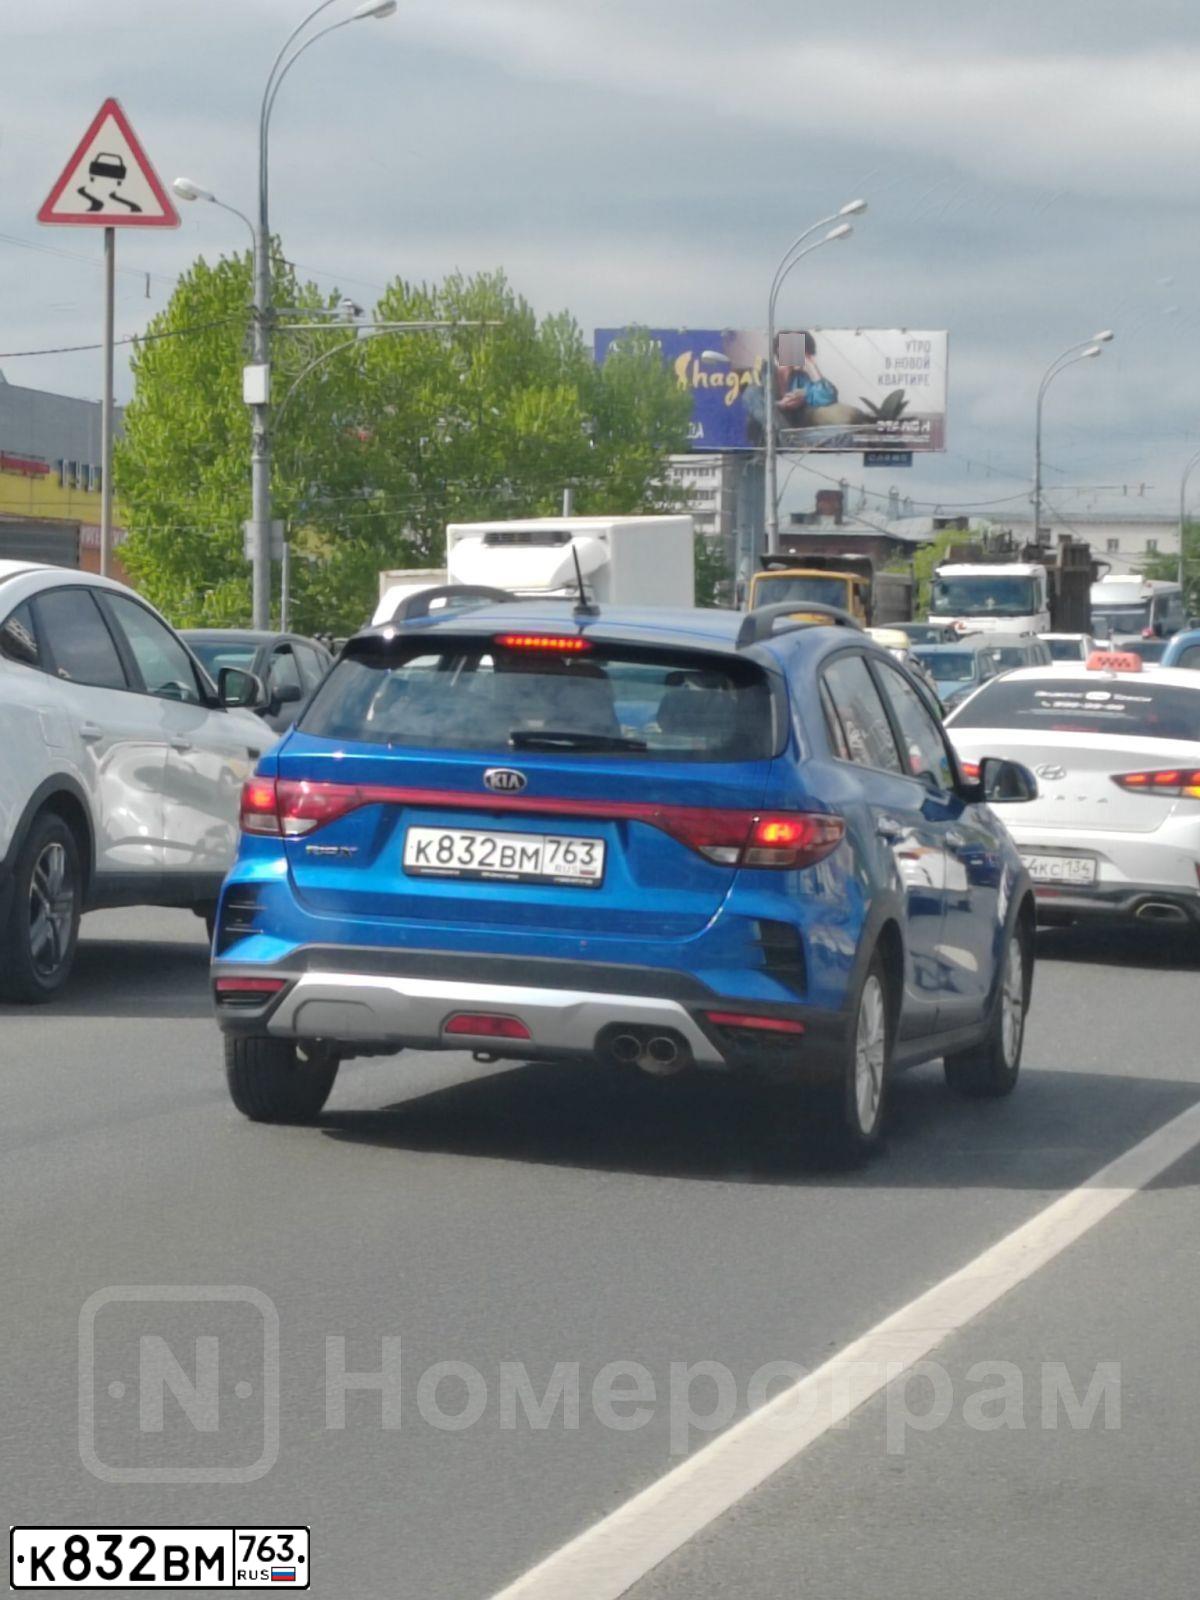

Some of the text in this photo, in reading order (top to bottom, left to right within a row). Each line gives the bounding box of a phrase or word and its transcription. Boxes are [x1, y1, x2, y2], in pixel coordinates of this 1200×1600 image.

[905, 340, 931, 352] УТРО
[895, 355, 930, 369] НОВОЙ
[878, 374, 930, 386] КВАРТИРЕ
[491, 774, 521, 788] KIA
[415, 835, 596, 871] К832ВМ 763
